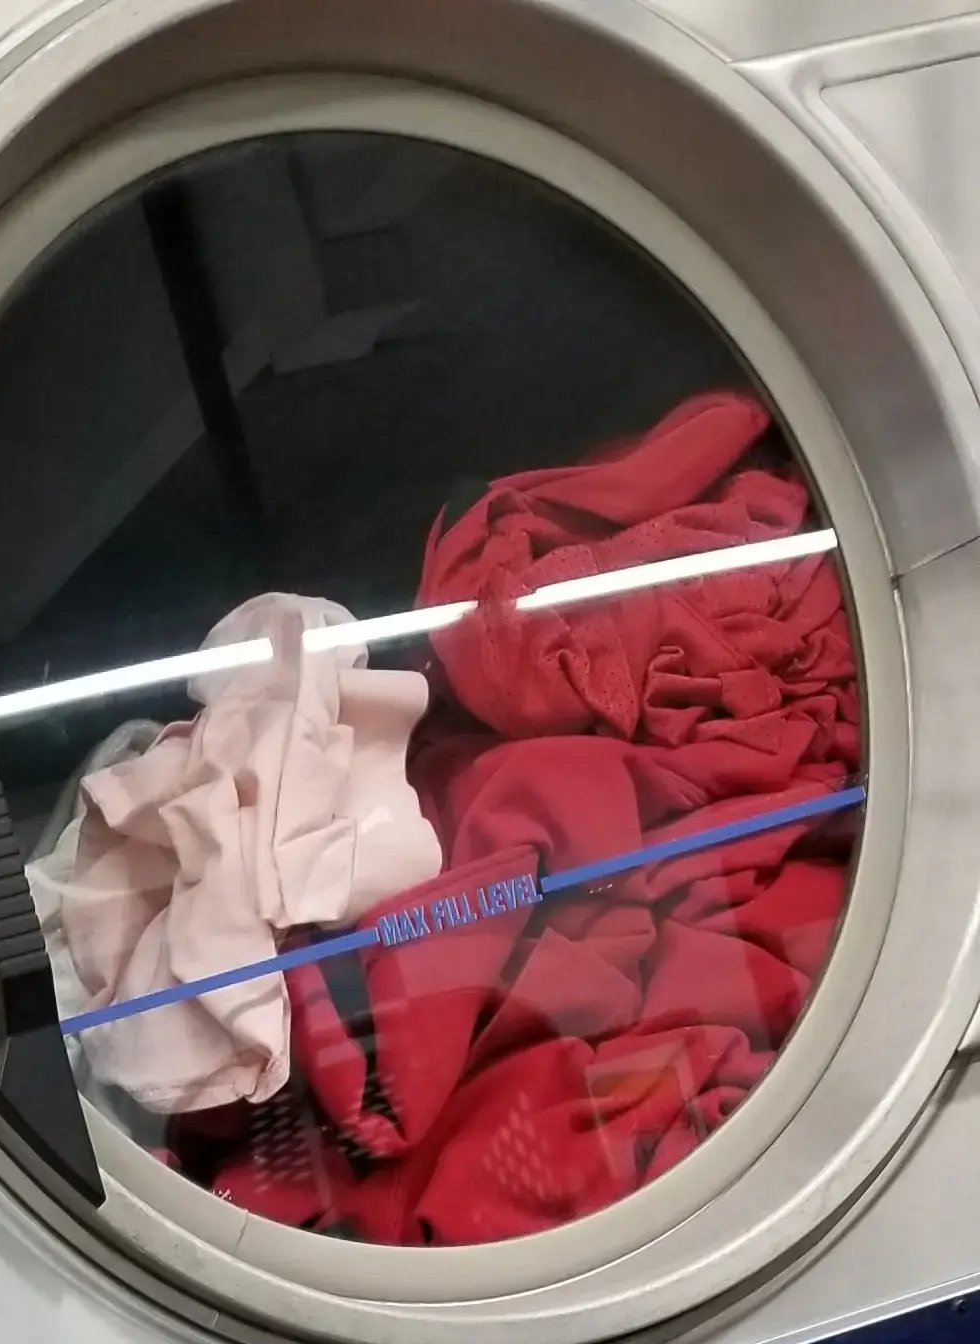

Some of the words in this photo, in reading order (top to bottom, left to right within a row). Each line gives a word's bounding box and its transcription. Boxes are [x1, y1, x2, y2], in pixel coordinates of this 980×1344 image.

[378, 905, 431, 946] MAX
[431, 892, 478, 931] FILL
[477, 873, 543, 916] LEVEL
